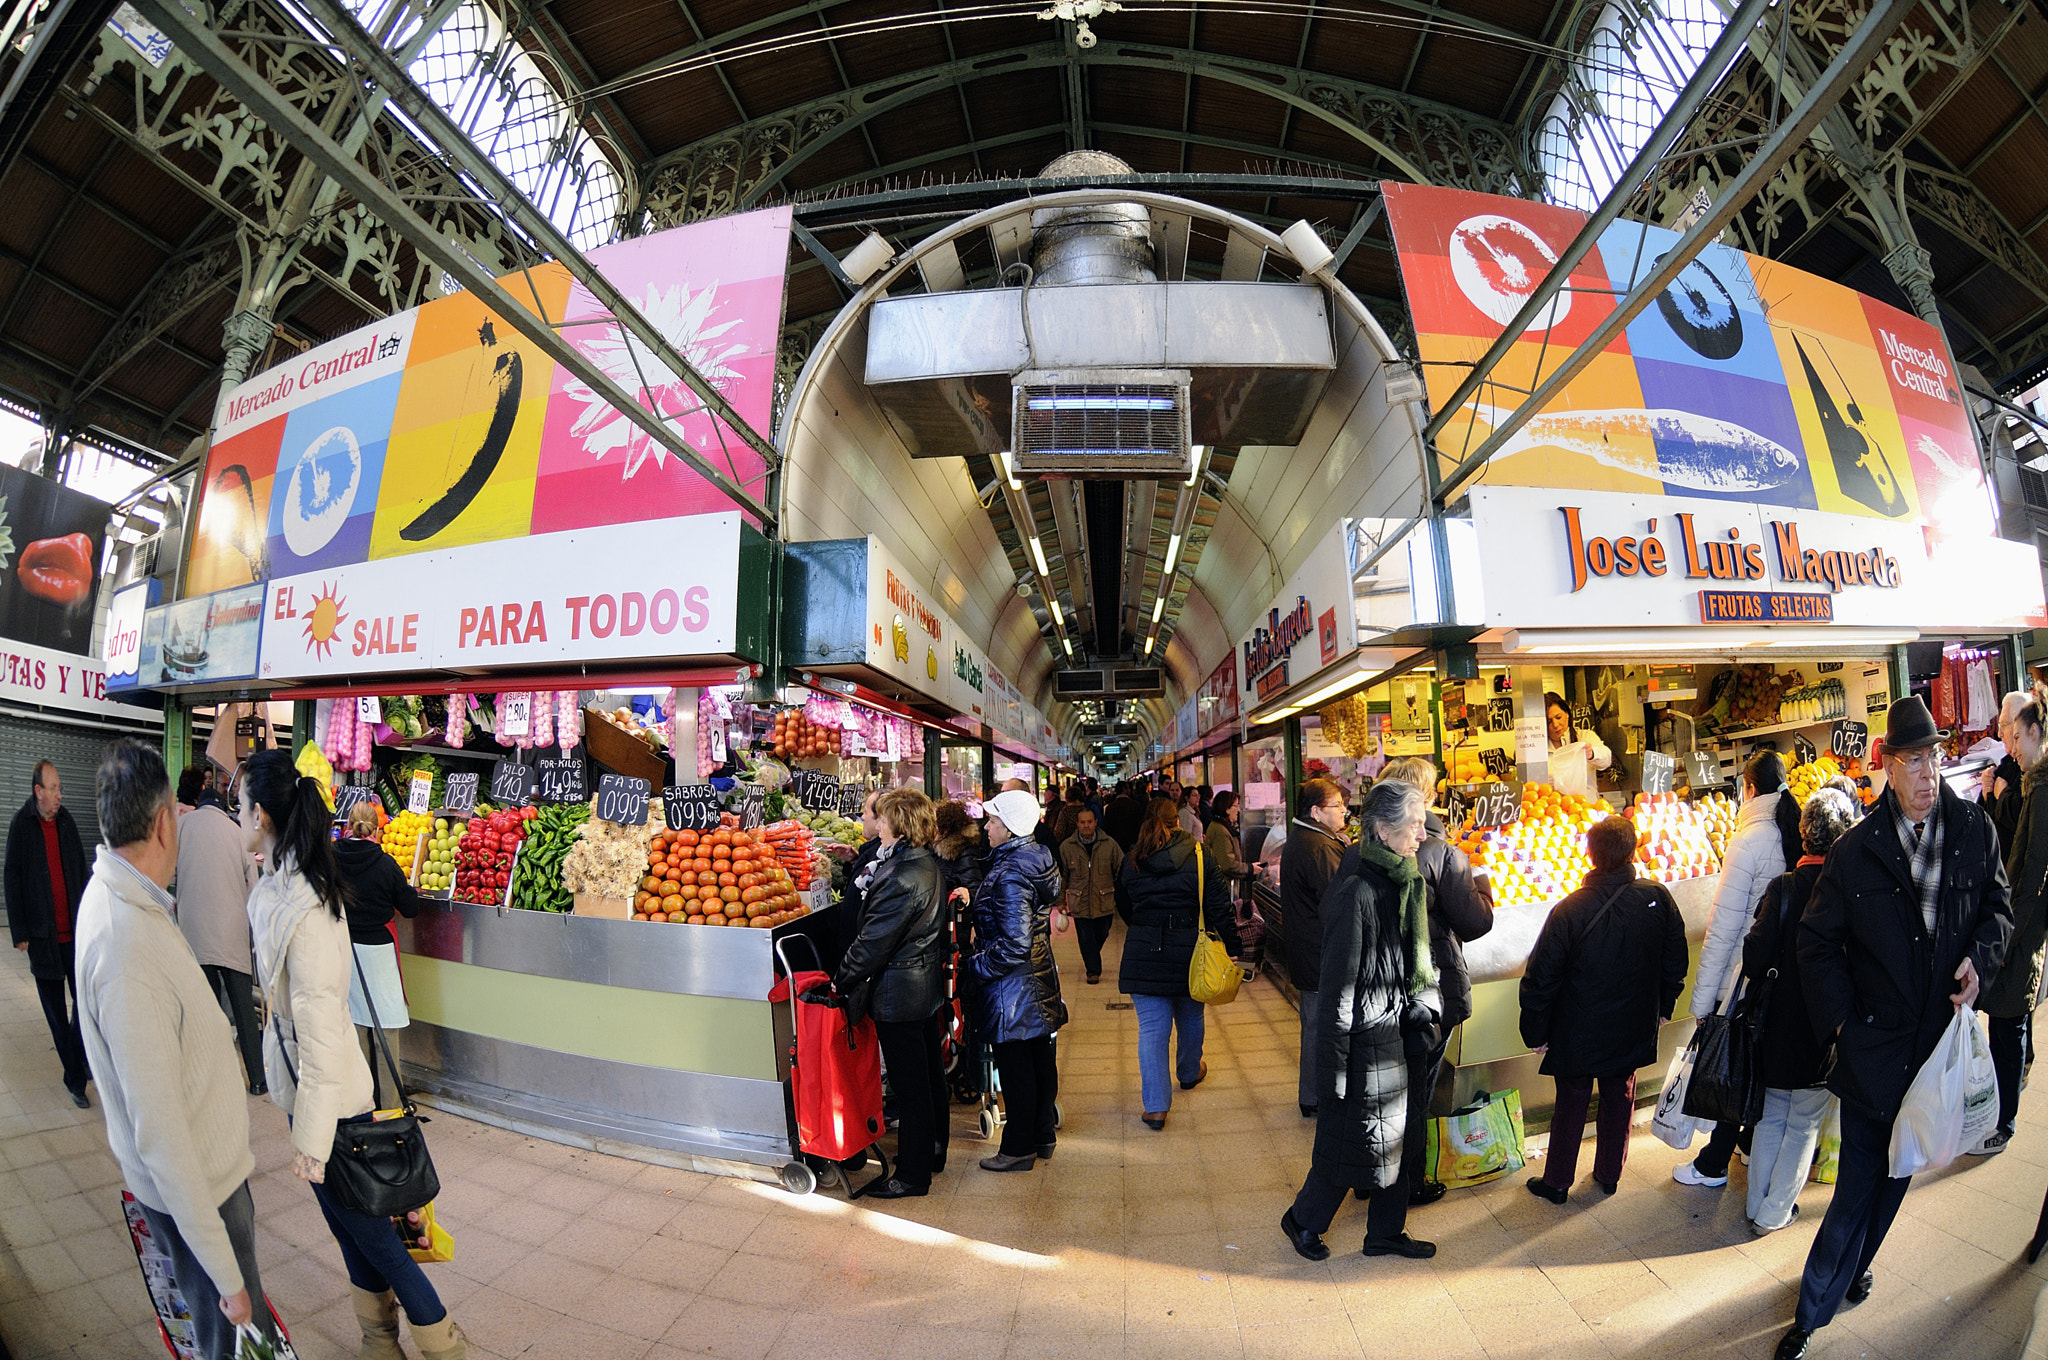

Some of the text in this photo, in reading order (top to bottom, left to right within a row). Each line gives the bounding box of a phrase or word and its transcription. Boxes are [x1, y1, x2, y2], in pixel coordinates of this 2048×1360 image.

[1878, 328, 1947, 378] Mercado
[223, 334, 378, 426] Mercado Central
[1891, 358, 1949, 402] Central
[1556, 506, 1903, 593] José Luis Maqueda
[1709, 594, 1831, 618] FRUTAS SELECTAS
[205, 600, 262, 629] Saturnino
[274, 585, 709, 657] EL SALE PARA TODOS
[108, 619, 138, 658] dro
[874, 622, 883, 647] 96
[263, 662, 272, 675] 96
[58, 664, 71, 694] Y
[1572, 706, 1592, 718] IEZA
[1650, 753, 1668, 768] FUJI
[1694, 751, 1710, 762] Kilo
[414, 770, 432, 781] OFERTA
[503, 763, 526, 777] KILO
[448, 773, 478, 784] GOLDEN
[807, 773, 840, 786] ESPECIAL
[665, 784, 717, 801] SABROSO
[1490, 783, 1510, 794] Kilo
[520, 795, 530, 806] €
[640, 791, 650, 804] €
[708, 799, 719, 810] €
